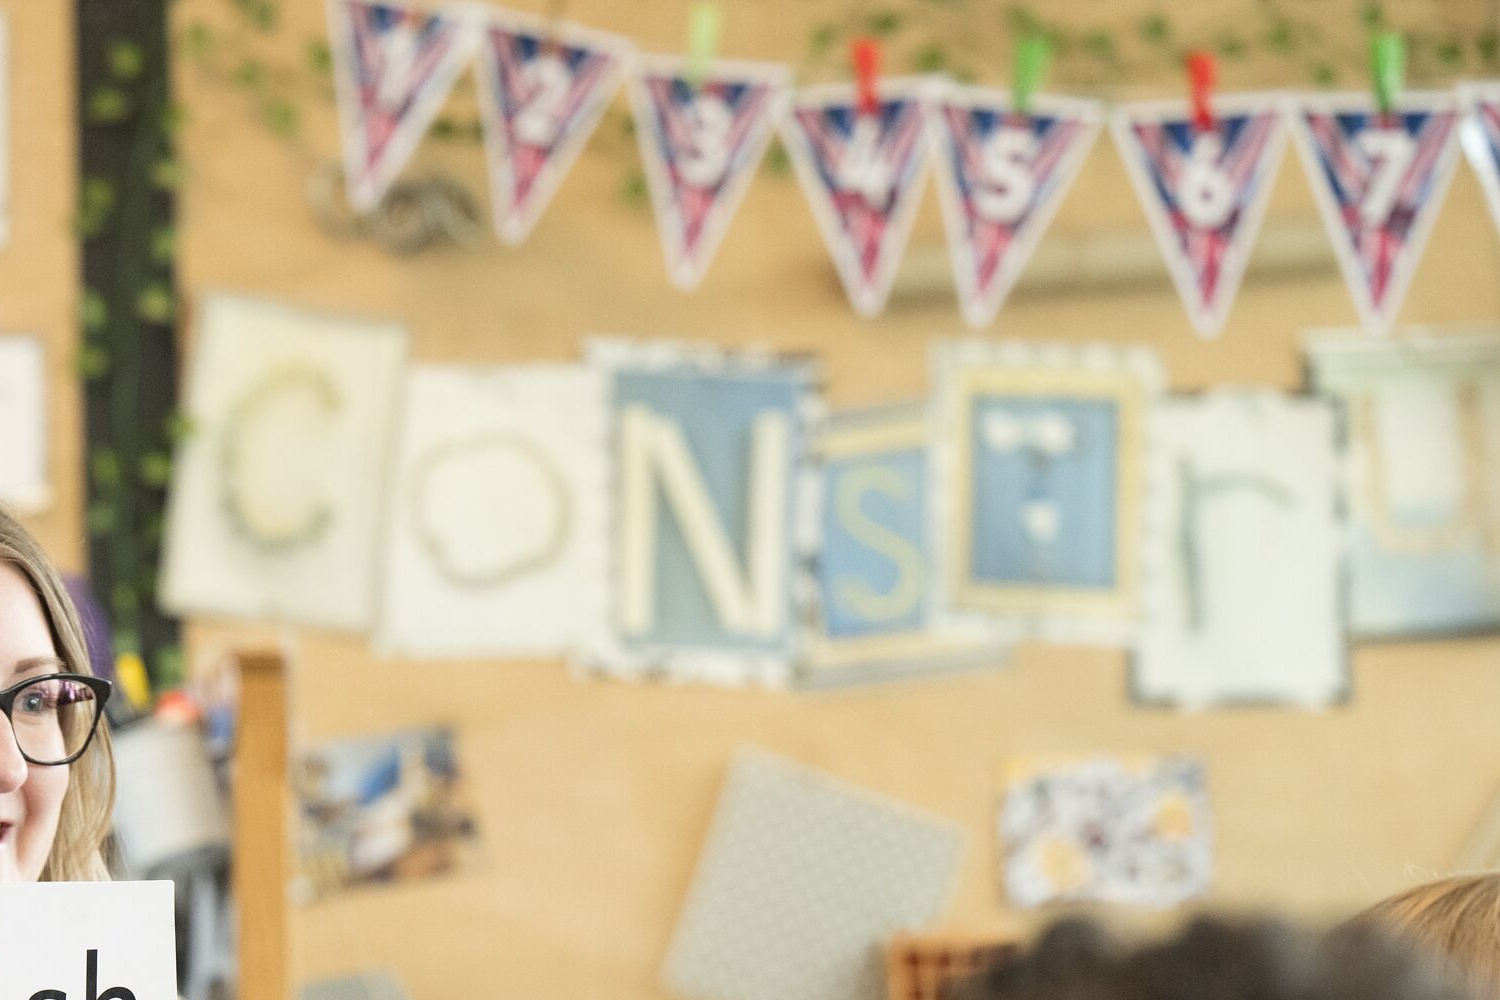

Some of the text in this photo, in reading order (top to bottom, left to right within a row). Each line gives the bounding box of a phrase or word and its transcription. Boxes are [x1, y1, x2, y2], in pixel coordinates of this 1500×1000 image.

[514, 58, 572, 146] 2
[678, 96, 734, 188] 3
[840, 120, 896, 204] 4
[974, 126, 1038, 220] 5
[1176, 126, 1234, 228] 6
[1358, 130, 1416, 228] 7
